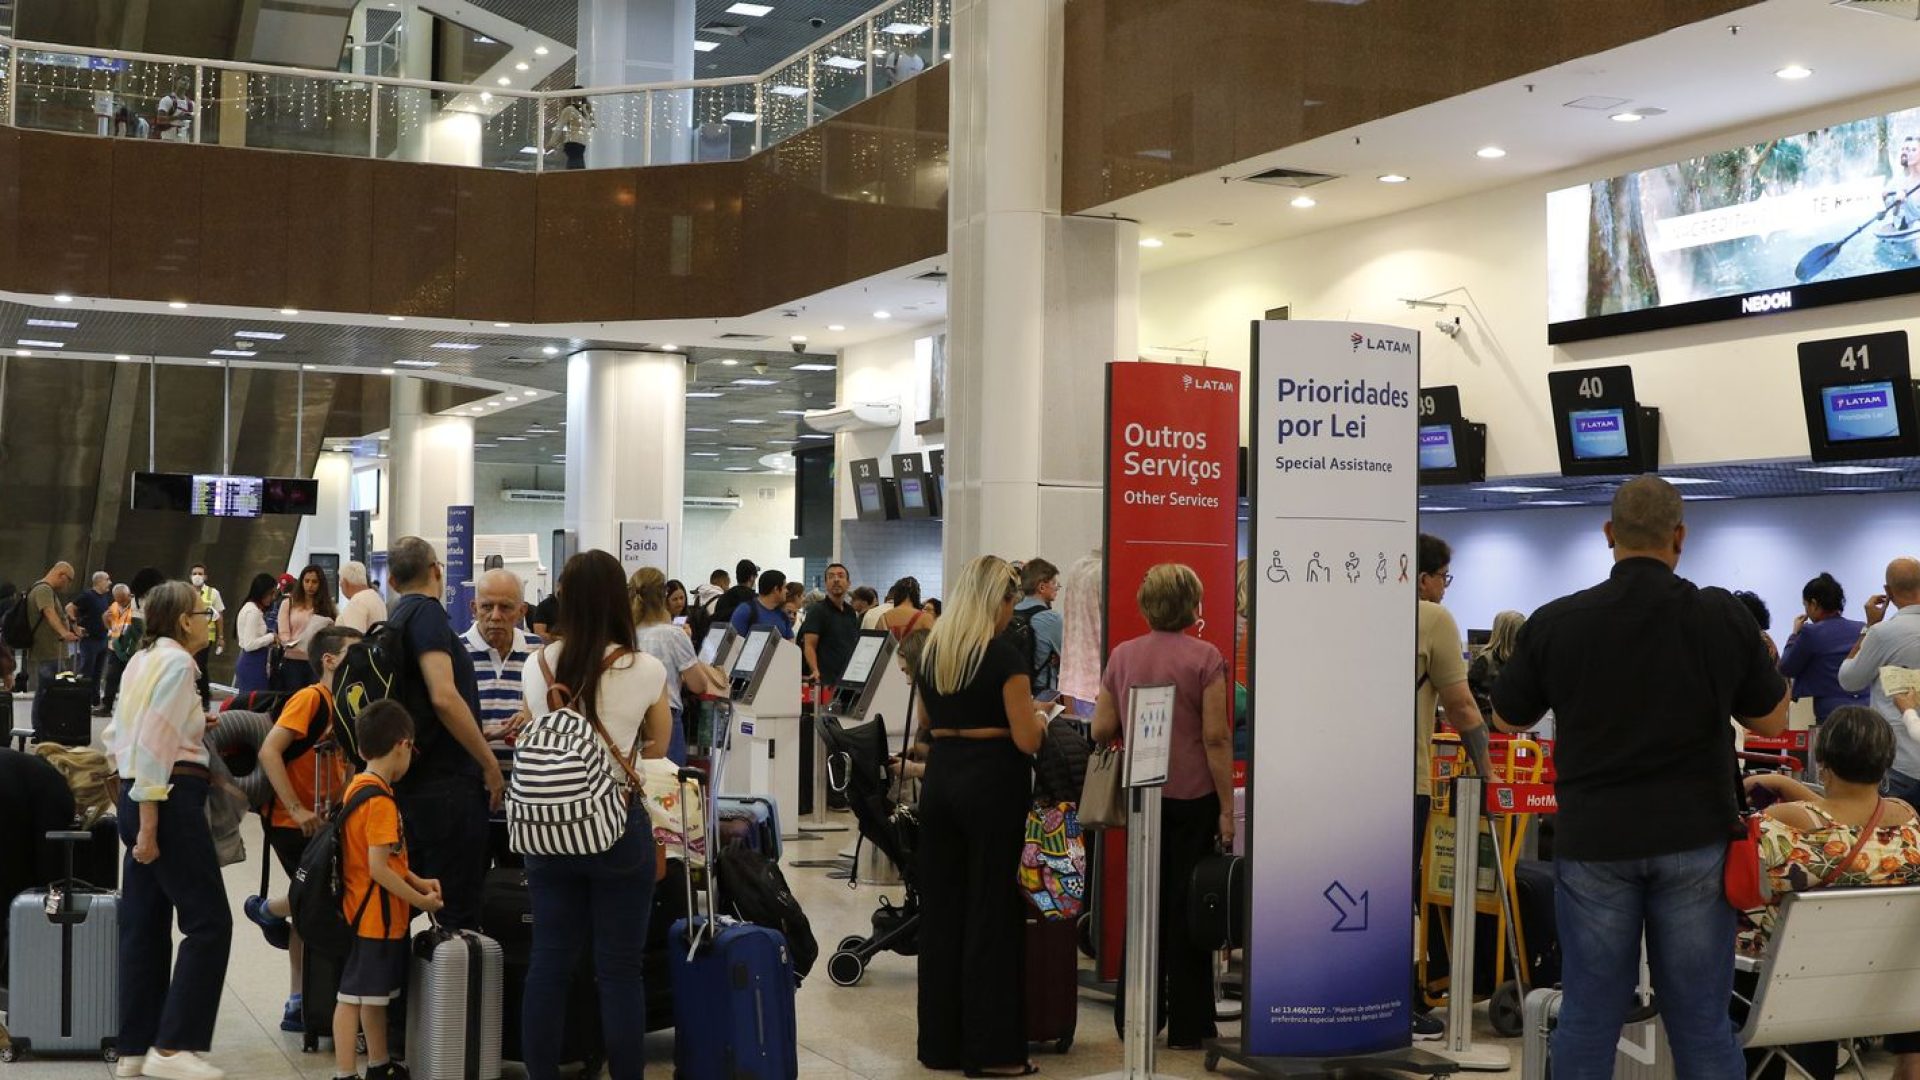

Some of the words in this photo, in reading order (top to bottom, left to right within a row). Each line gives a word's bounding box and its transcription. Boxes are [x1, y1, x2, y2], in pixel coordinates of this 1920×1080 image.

[1742, 291, 1792, 313] NEOOH
[1367, 338, 1412, 354] LATAM
[1840, 344, 1870, 371] 41
[1195, 379, 1234, 392] LATAM
[1278, 378, 1409, 409] Prioridades
[1578, 376, 1604, 399] 40
[1845, 396, 1882, 406] LATAM
[1278, 418, 1323, 444] por
[1331, 413, 1366, 438] Lei
[1587, 420, 1615, 429] LATAM
[1124, 423, 1207, 450] Outros
[859, 463, 870, 477] 32
[902, 458, 913, 472] 33
[1124, 451, 1222, 485] Serviços
[1276, 456, 1326, 473] Special
[1329, 457, 1393, 473] Assistance
[1124, 490, 1166, 505] Other
[1169, 492, 1219, 508] Services
[1527, 794, 1558, 807] HotM
